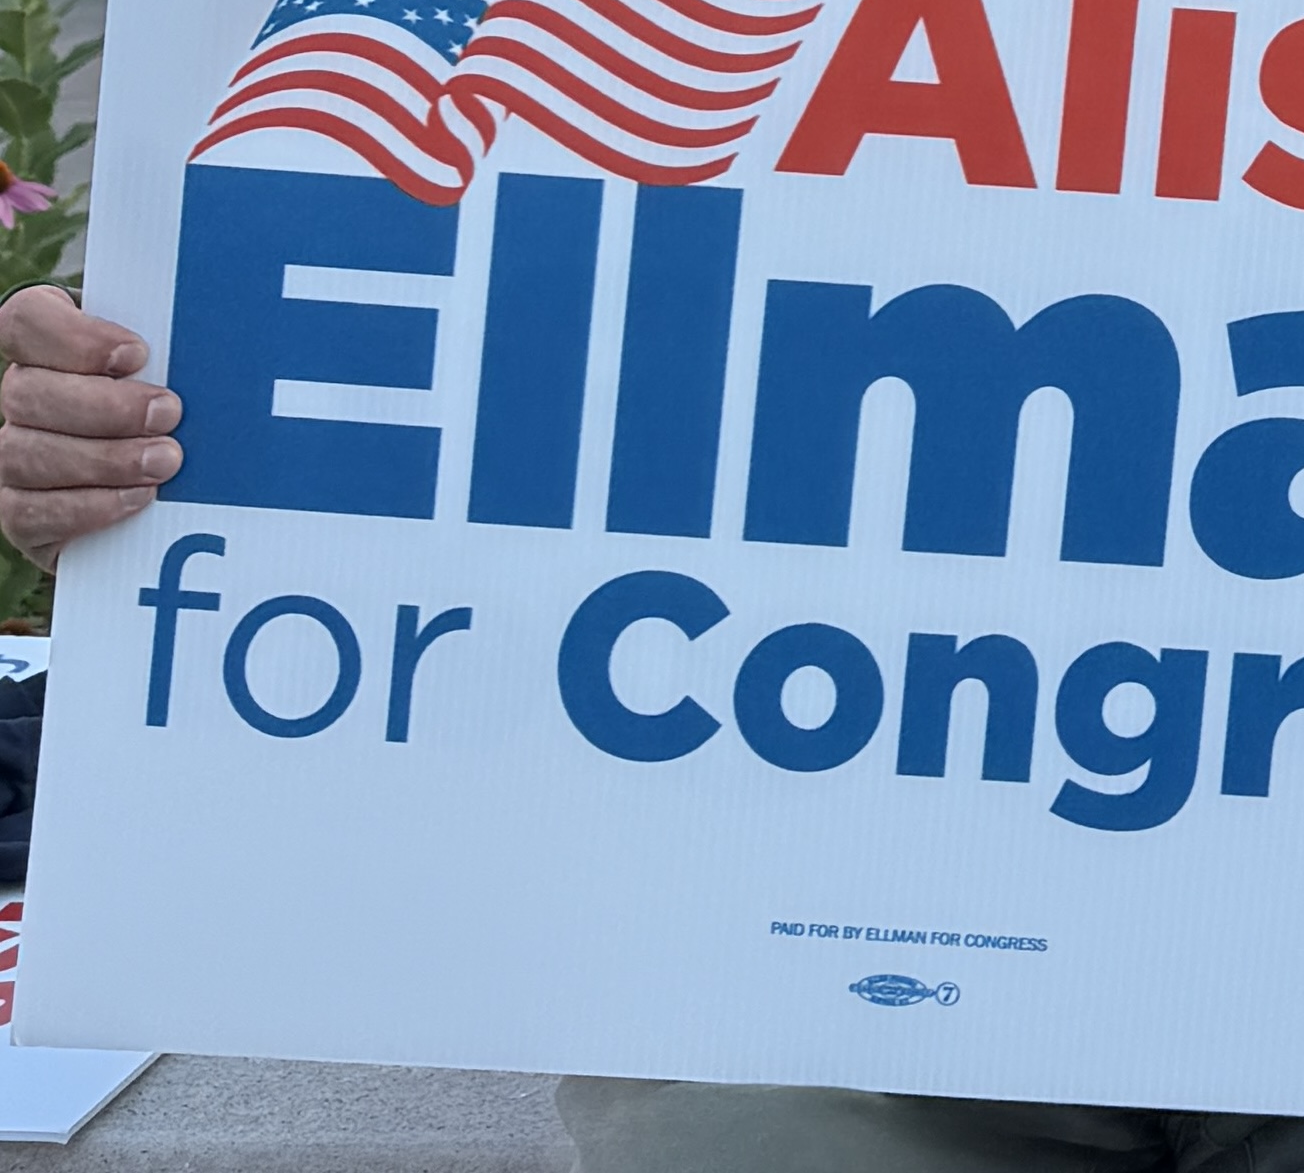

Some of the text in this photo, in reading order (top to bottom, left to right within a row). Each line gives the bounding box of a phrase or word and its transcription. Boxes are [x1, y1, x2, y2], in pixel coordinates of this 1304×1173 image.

[137, 532, 474, 745] for
[770, 921, 1048, 952] PAID FOR BY ELLMAN FOR CONGRESS
